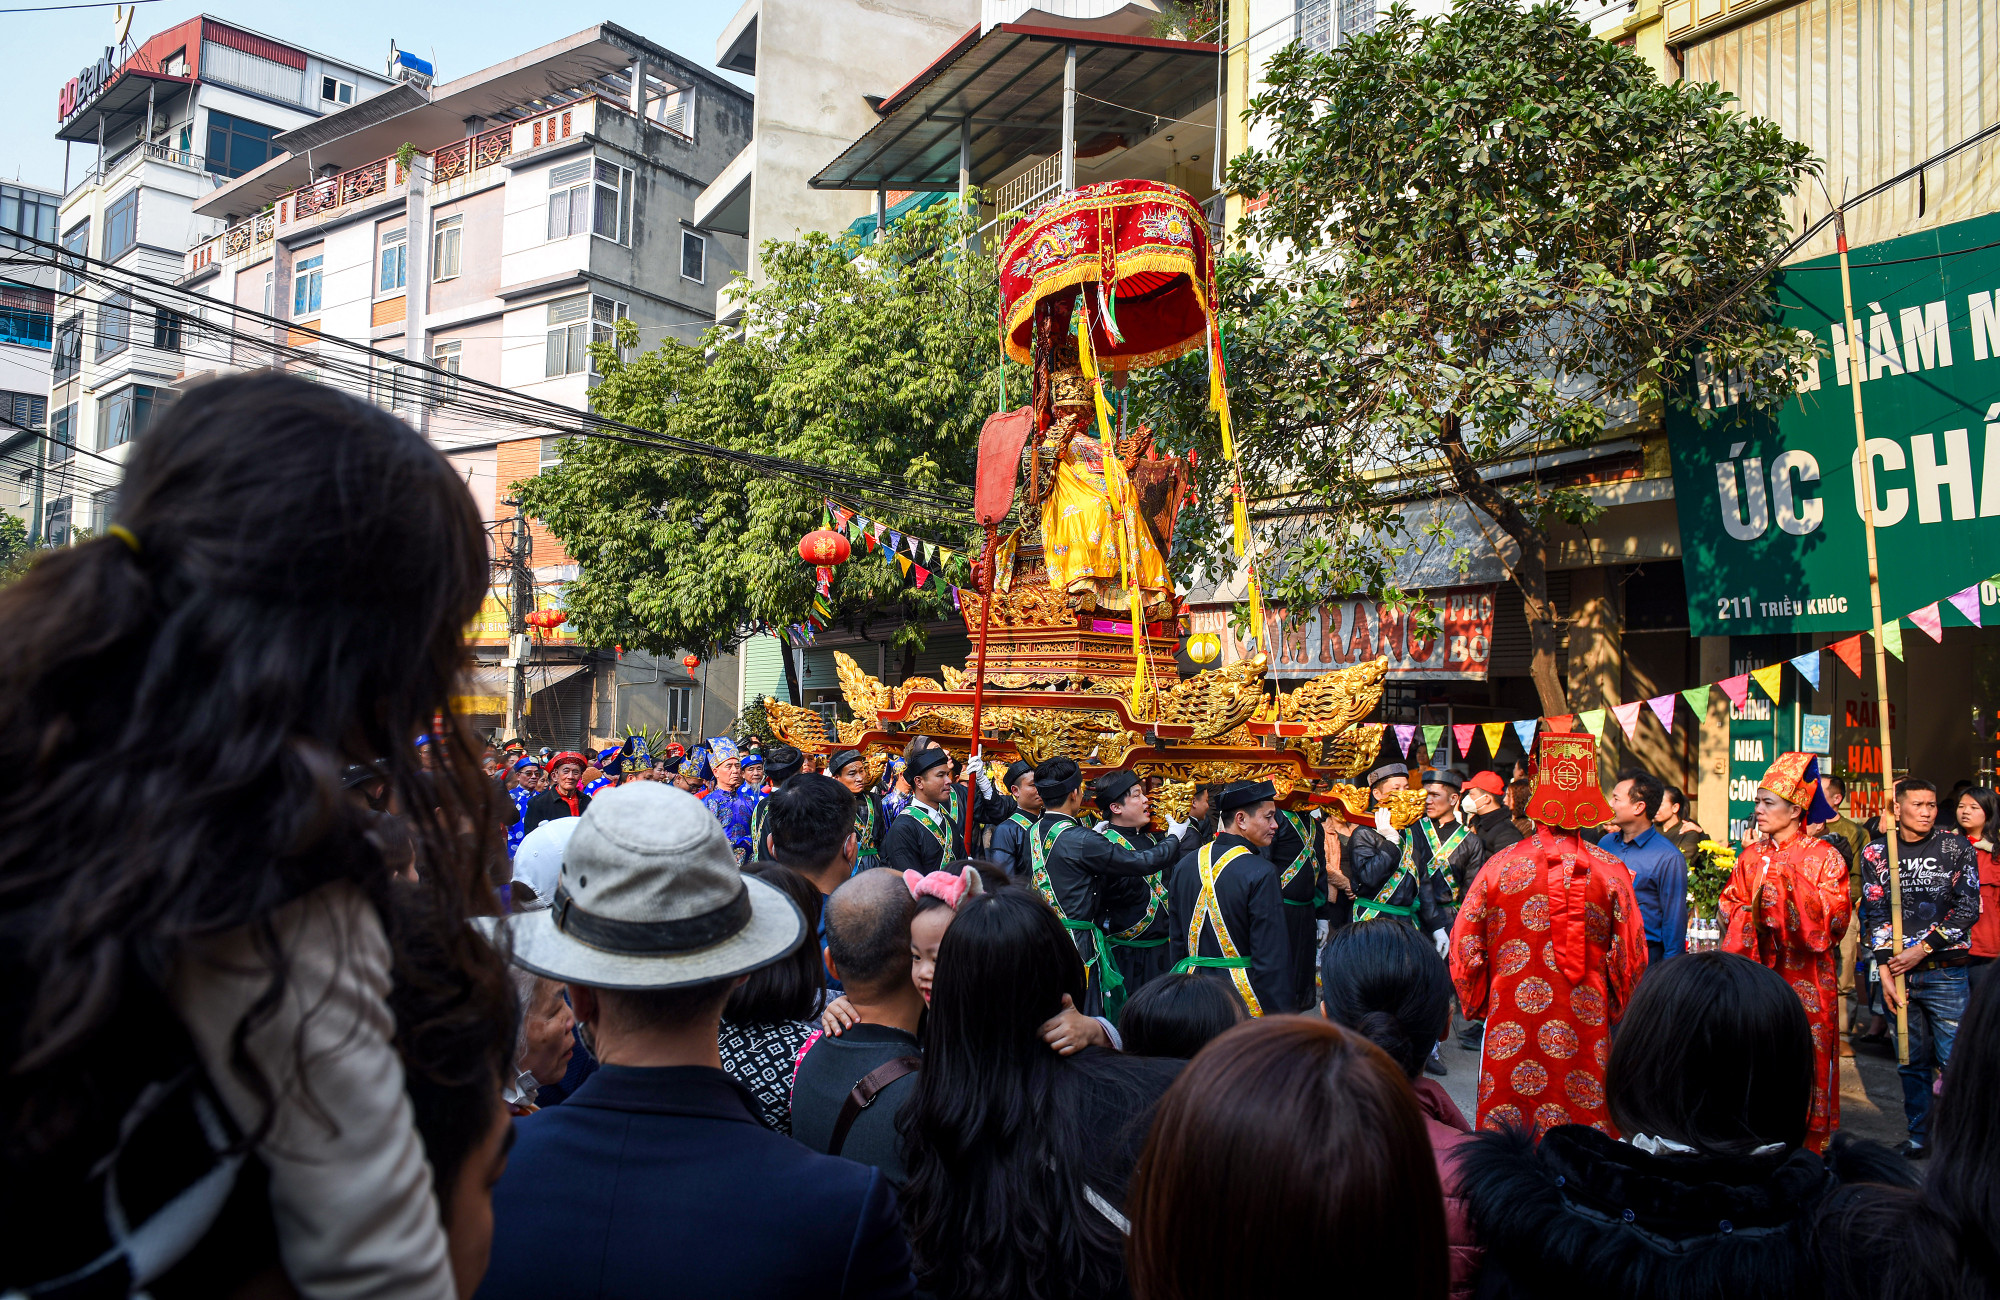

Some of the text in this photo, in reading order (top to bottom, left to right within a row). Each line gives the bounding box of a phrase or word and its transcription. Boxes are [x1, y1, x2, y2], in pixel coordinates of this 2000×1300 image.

[58, 46, 115, 123] HDBank
[1831, 301, 1953, 386] HÀM
[1716, 441, 1824, 541] ÚC
[1718, 594, 1848, 620] 211 TRIỀU KHÚC
[1448, 626, 1489, 663] BÒ
[1734, 739, 1764, 762] NHA
[1729, 775, 1761, 802] CÔN
